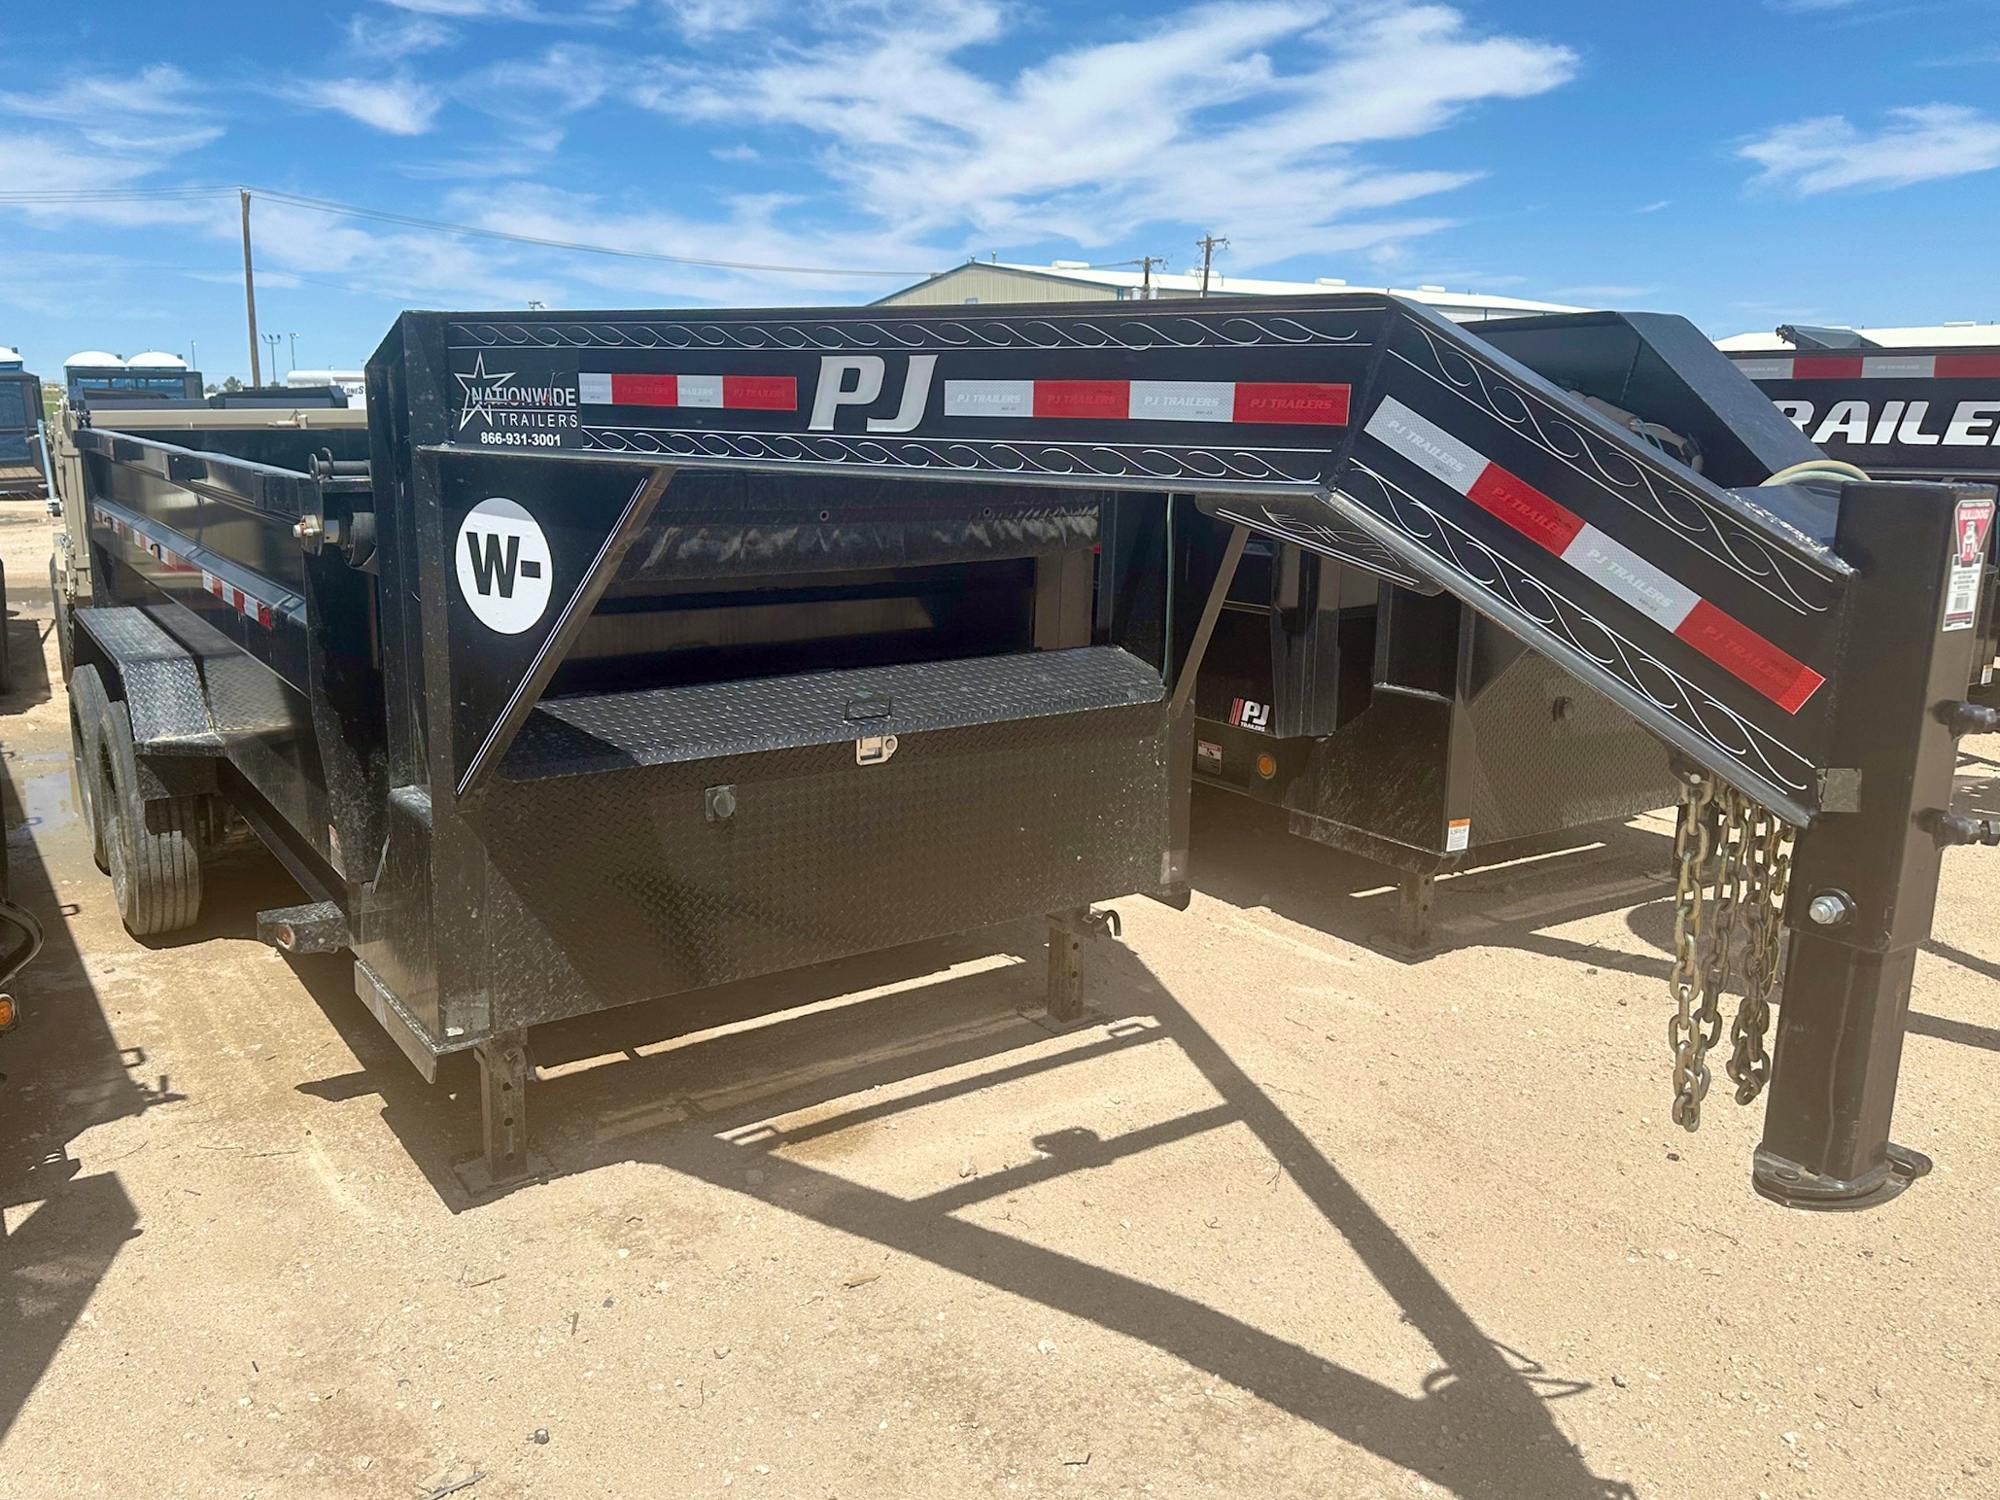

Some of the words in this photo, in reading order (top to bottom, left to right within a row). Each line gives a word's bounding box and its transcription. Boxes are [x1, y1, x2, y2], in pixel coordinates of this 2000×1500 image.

[471, 386, 577, 407] NATIONWIDE
[808, 354, 939, 433] PJ
[957, 393, 971, 403] PJ
[973, 394, 1021, 404] TRAILERS
[1144, 395, 1161, 406] PJ
[1163, 396, 1220, 407] TRAILERS
[1251, 399, 1267, 409] PJ
[1271, 399, 1333, 410] TRAILERS
[500, 413, 578, 428] TRAILERS
[1772, 401, 2000, 446] RAILE
[480, 431, 561, 447] 866-931-3001
[1387, 420, 1407, 435] PJ
[1406, 430, 1466, 473] TRAILERS
[1492, 487, 1512, 502] PJ
[465, 531, 541, 599] W-
[1587, 549, 1608, 564] PJ
[1607, 561, 1674, 608] TRAILERS
[1241, 700, 1270, 726] PJ
